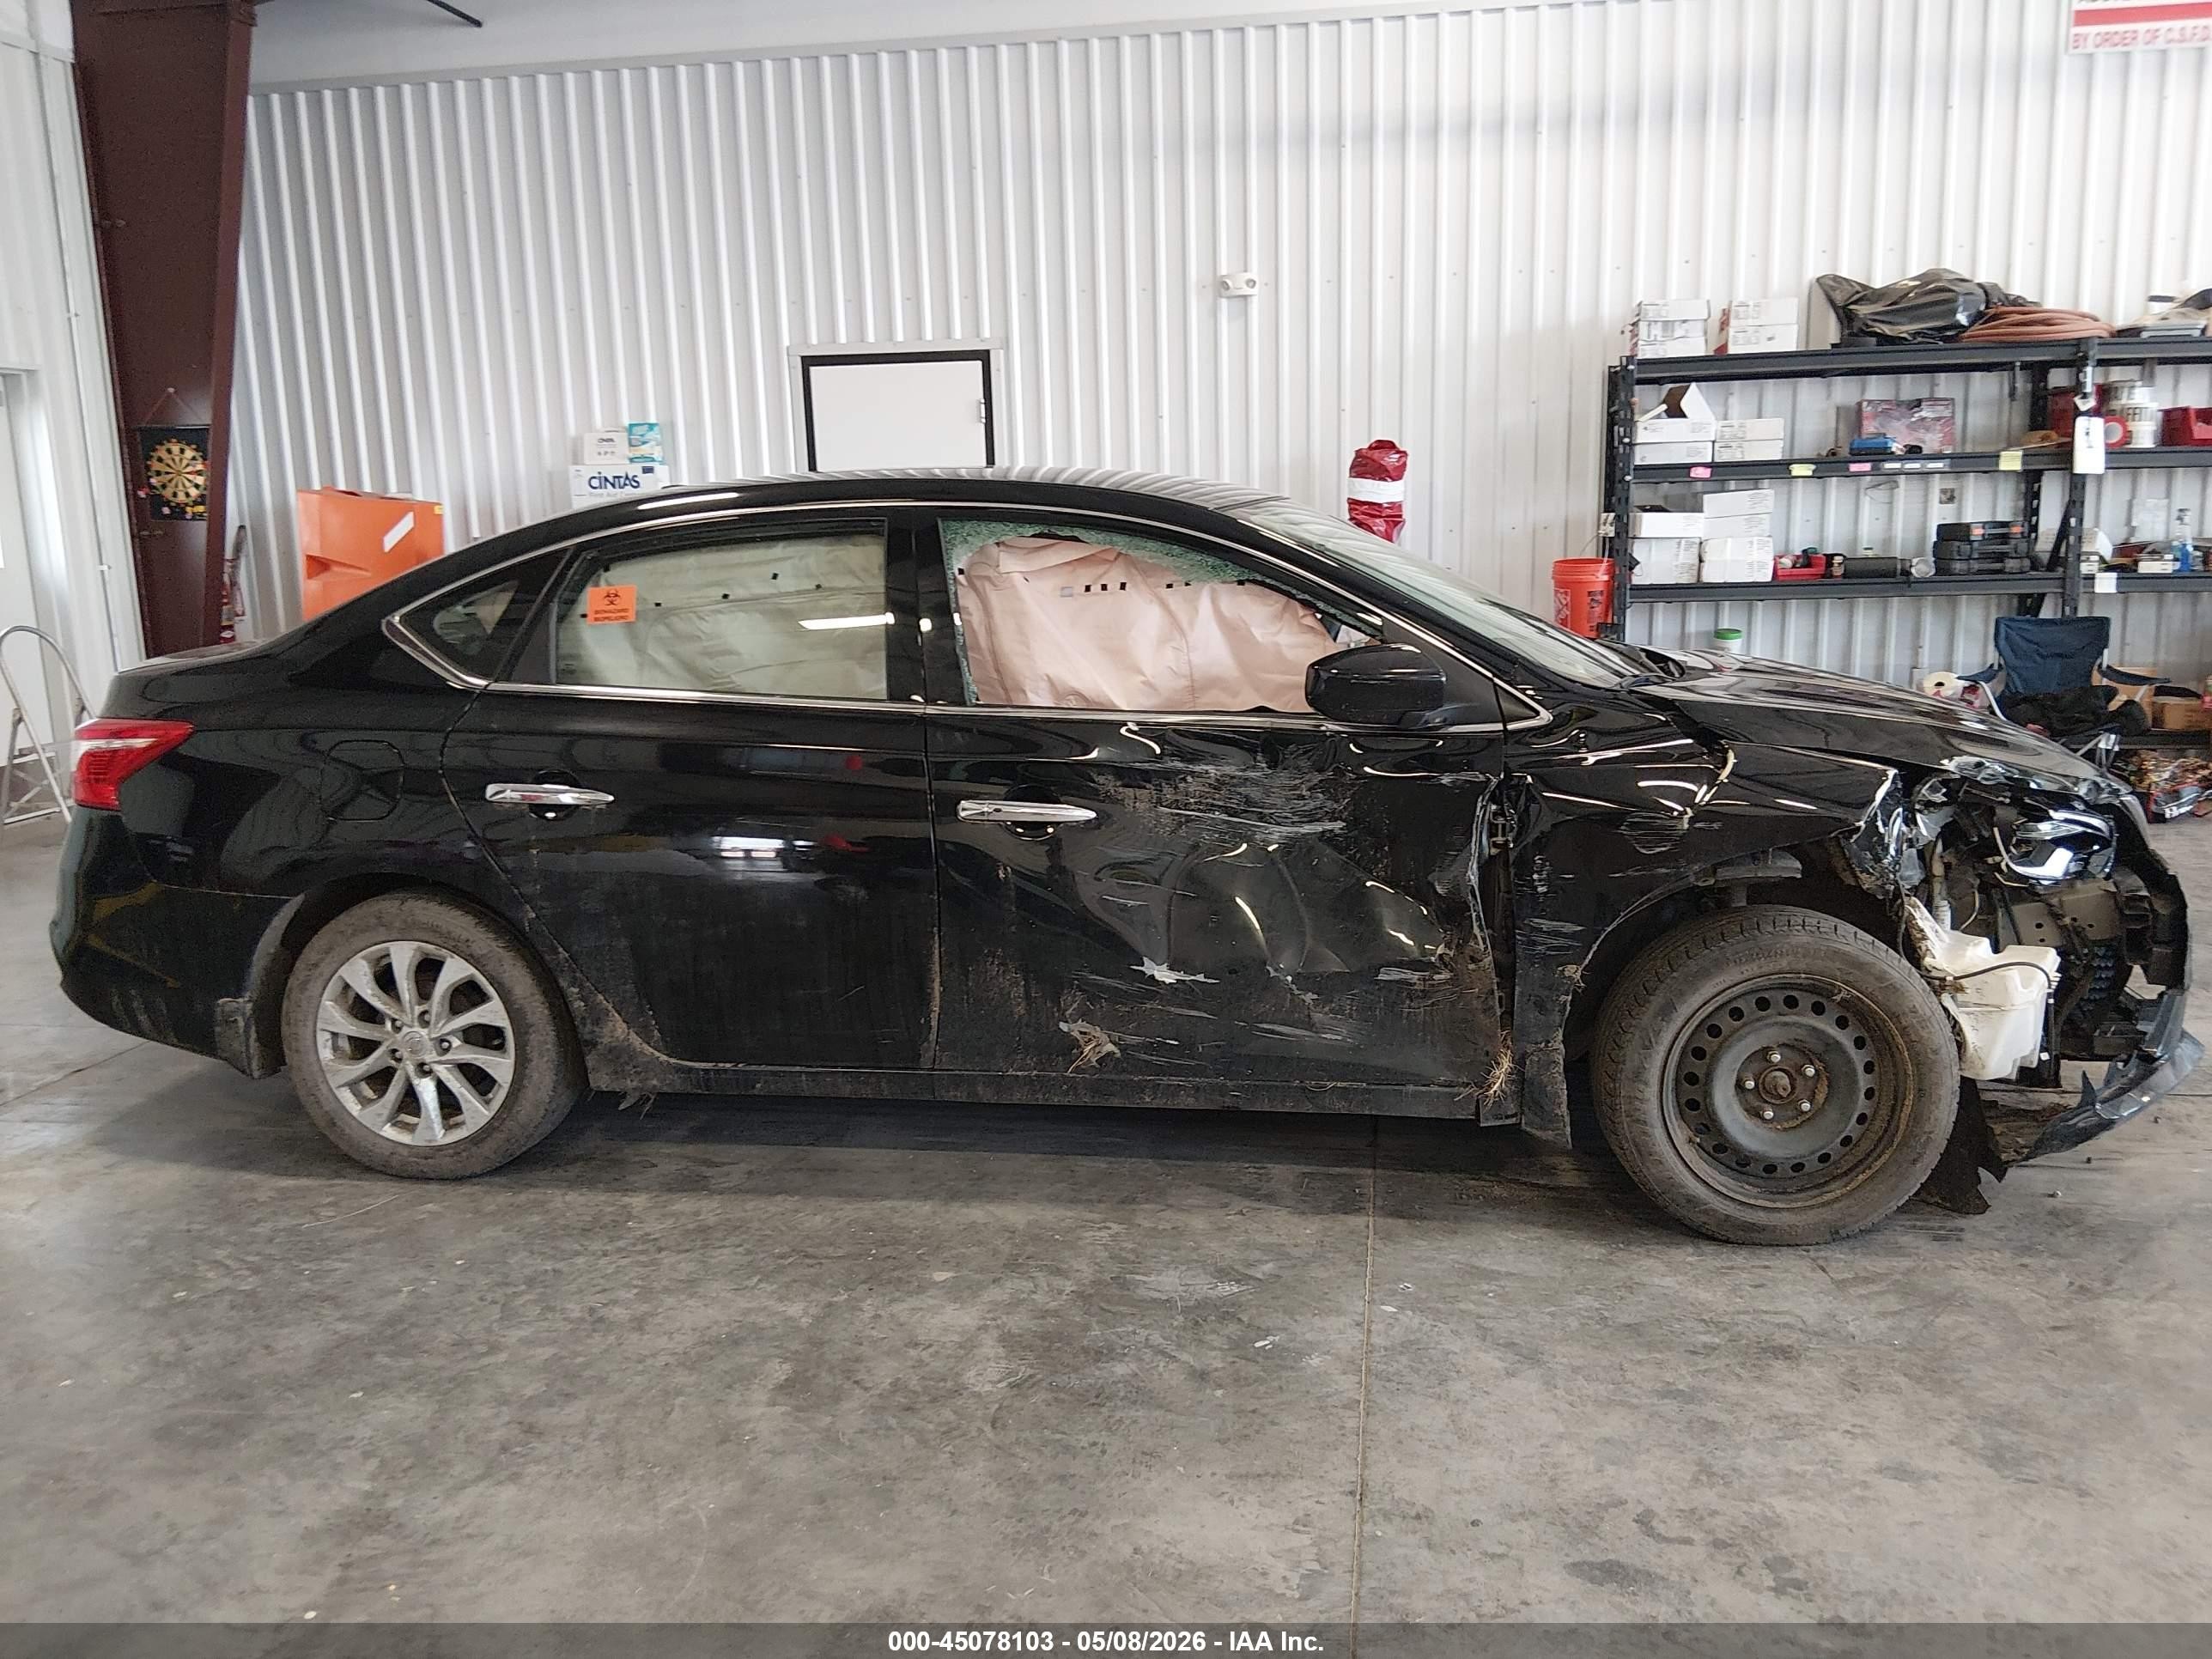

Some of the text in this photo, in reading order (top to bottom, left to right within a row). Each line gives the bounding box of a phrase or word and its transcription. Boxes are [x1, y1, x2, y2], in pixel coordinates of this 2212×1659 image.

[2072, 33, 2088, 49] BY
[2094, 29, 2139, 48] ORDER
[2142, 27, 2160, 46] OF
[588, 471, 641, 490] CINTAS
